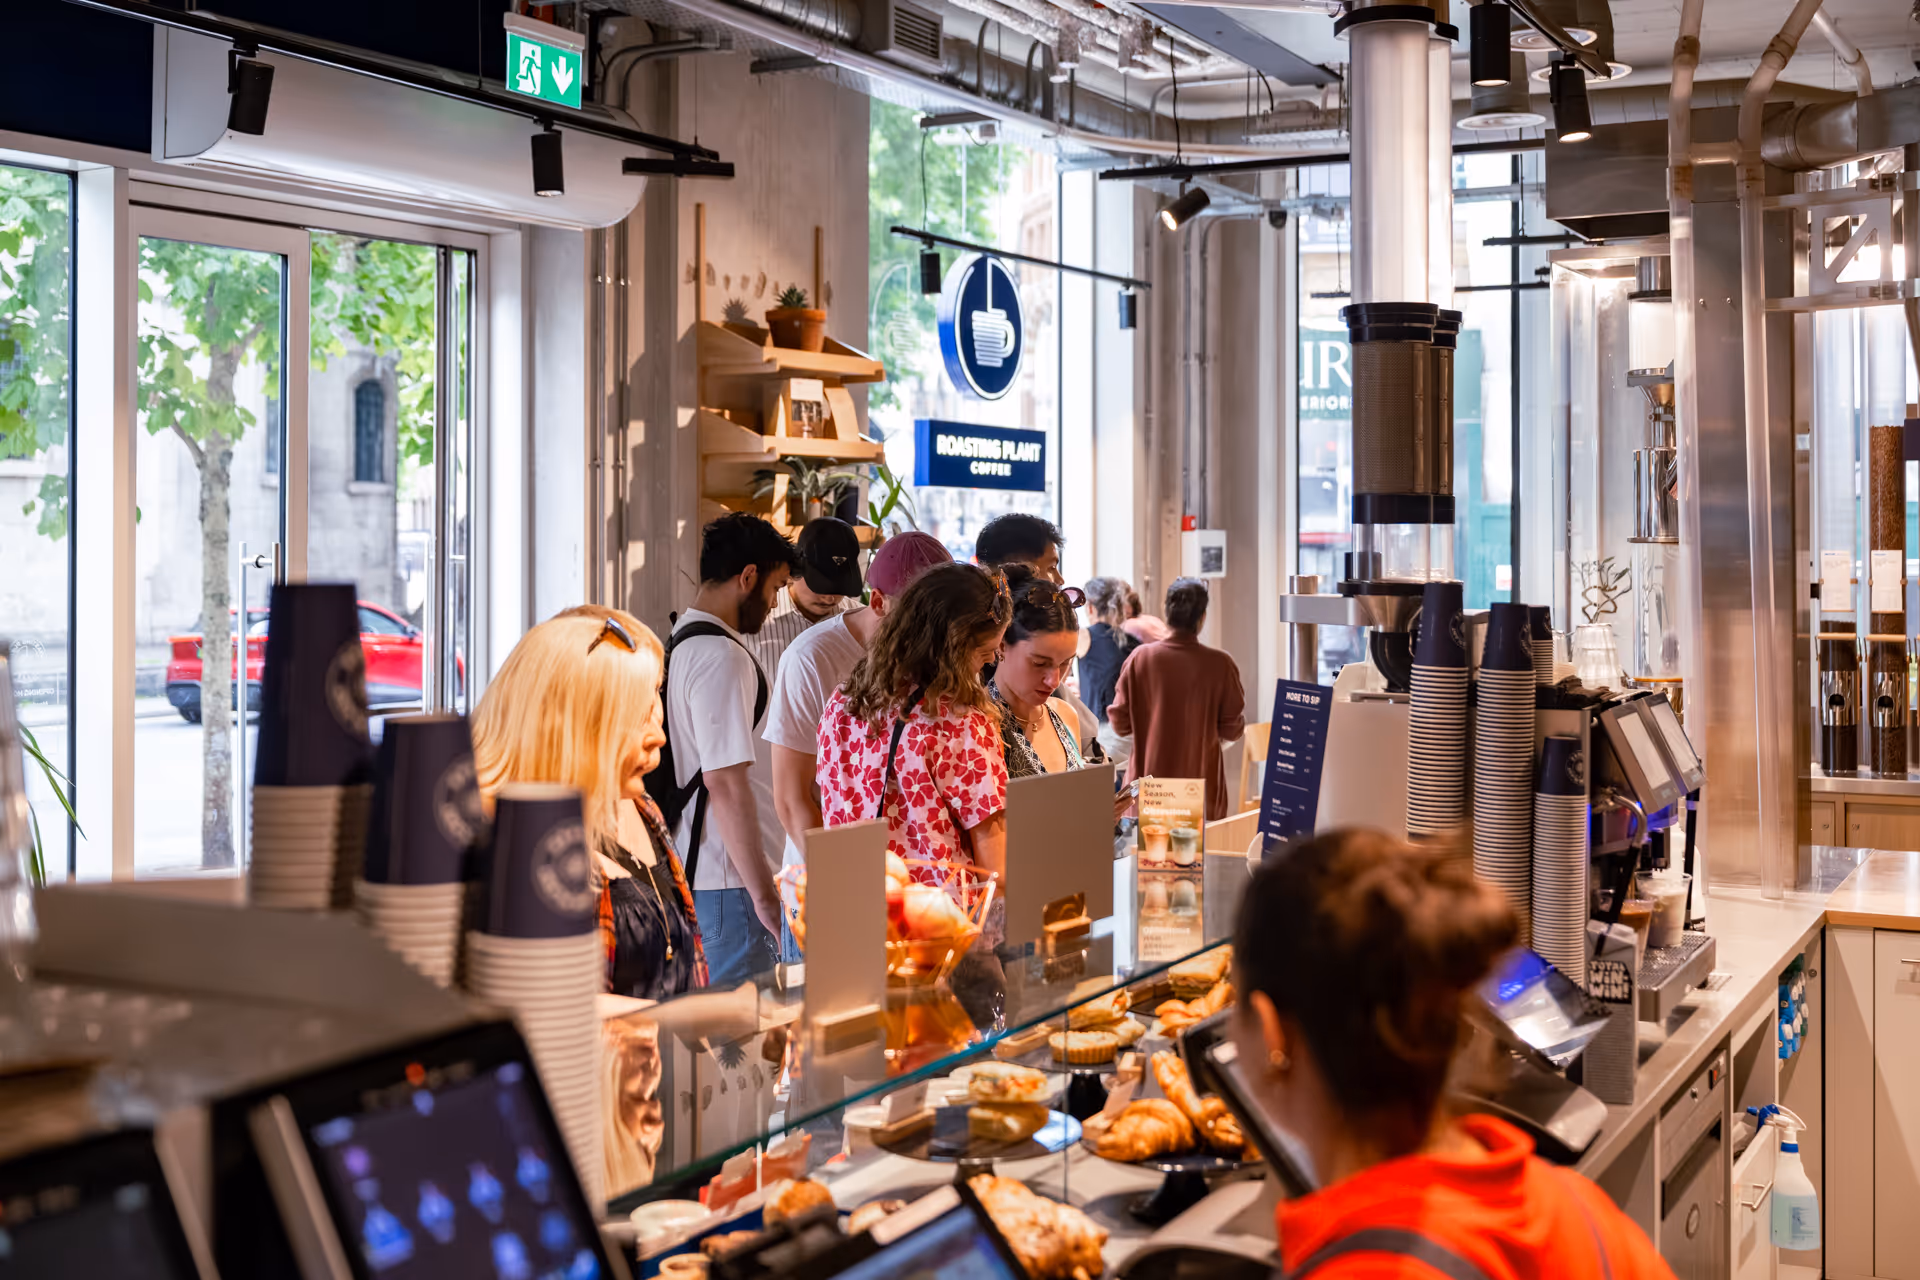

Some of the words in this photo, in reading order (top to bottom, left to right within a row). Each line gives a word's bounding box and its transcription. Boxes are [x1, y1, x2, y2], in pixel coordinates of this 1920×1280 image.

[937, 434, 1001, 459] ROASTING
[1002, 440, 1042, 462] PLANT
[970, 461, 1012, 476] COFFEE
[1286, 691, 1302, 702] MORE
[1302, 694, 1310, 704] TO
[1311, 695, 1320, 705] SIP
[1590, 960, 1626, 970] TOTAL
